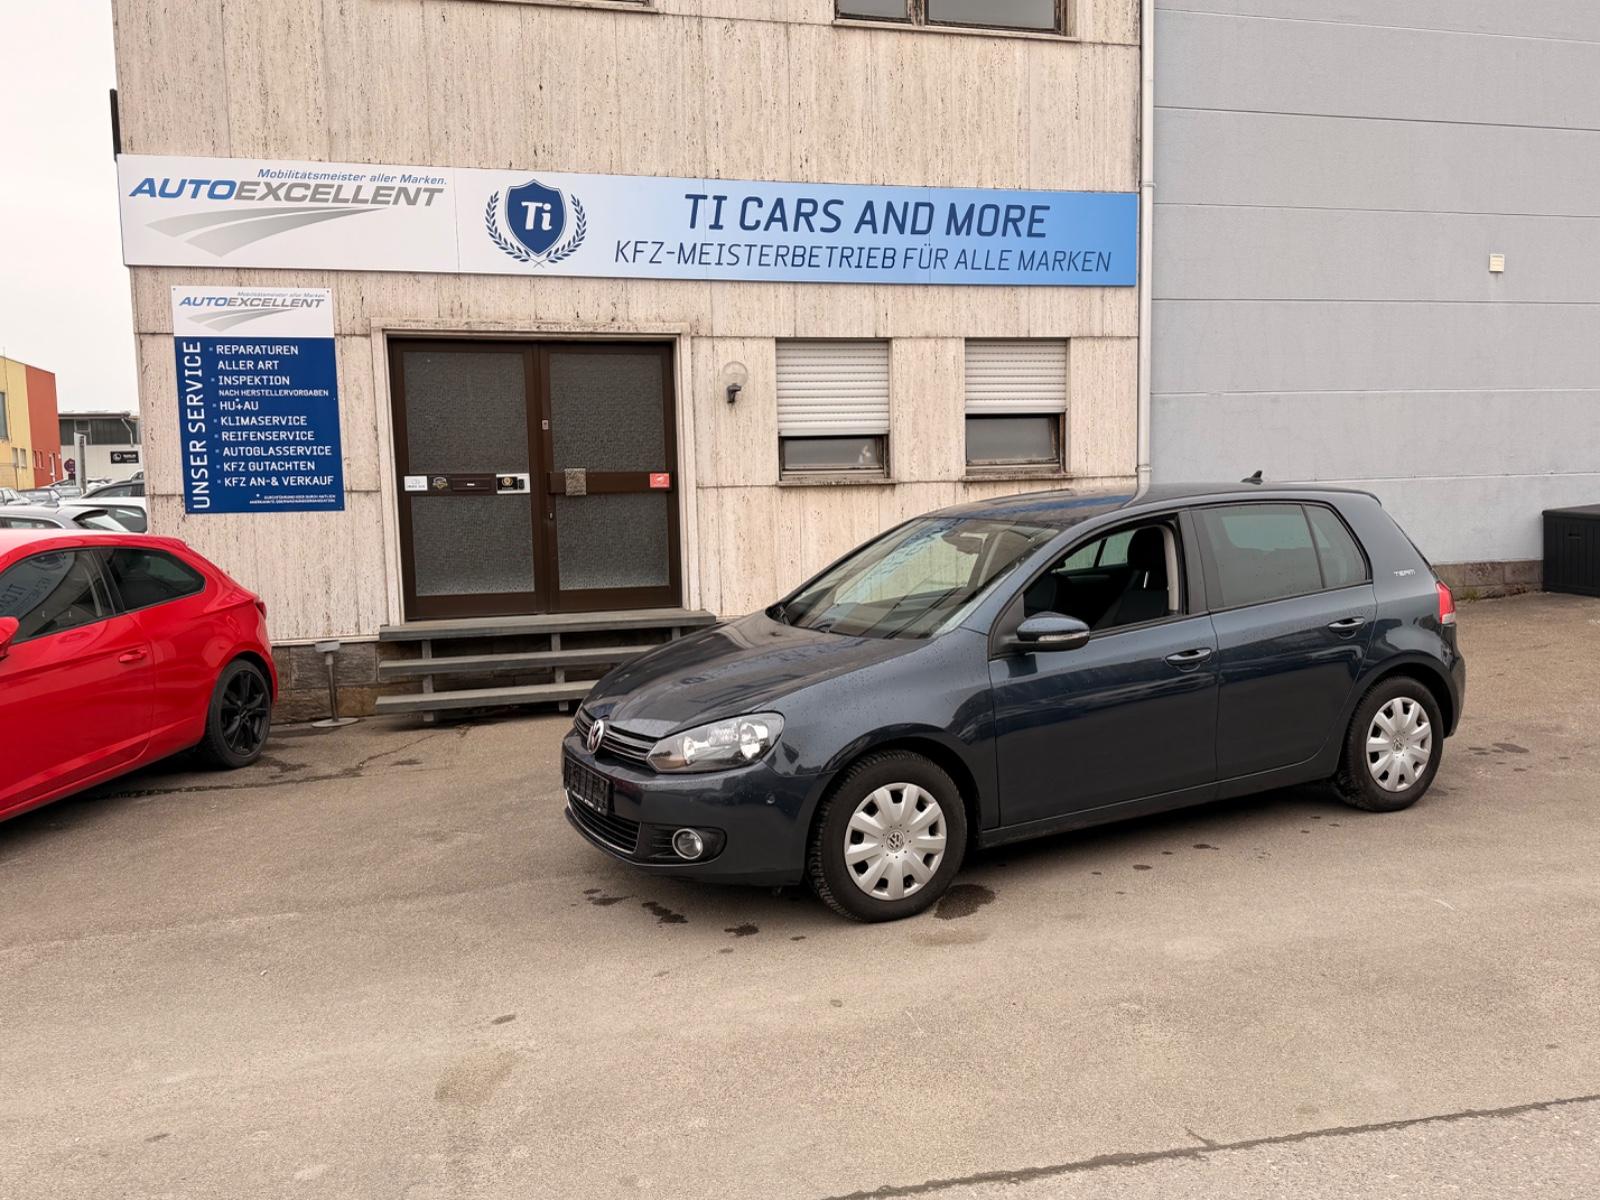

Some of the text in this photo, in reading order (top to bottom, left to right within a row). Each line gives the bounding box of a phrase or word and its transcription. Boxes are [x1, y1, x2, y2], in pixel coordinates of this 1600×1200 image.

[370, 173, 397, 183] aller
[400, 174, 447, 185] Marken.
[129, 177, 444, 206] AUTOEXCELLENT
[521, 200, 552, 231] Ti
[685, 193, 1050, 238] TI CARS AND MORE
[614, 239, 1112, 273] KFZ-MEISTERBETRIEB FÜR ALLE MARKEN
[179, 296, 325, 308] AUTOEXCELLENT
[216, 344, 298, 355] REPARATUREN
[217, 360, 279, 370] ALLER ART
[218, 375, 290, 386] INSPEKTION
[218, 389, 329, 397] NACH HERSTELLERVORGABEN
[183, 341, 211, 509] UNSER SERVICE
[220, 416, 307, 426] KLIMASERVICE
[221, 431, 315, 441] REIFENSERVICE
[222, 445, 332, 457] AUTOGLASSERVICE
[223, 461, 315, 472] KFZ GUTACHTEN
[224, 477, 246, 487] KFZ
[282, 475, 334, 487] VERKAUF
